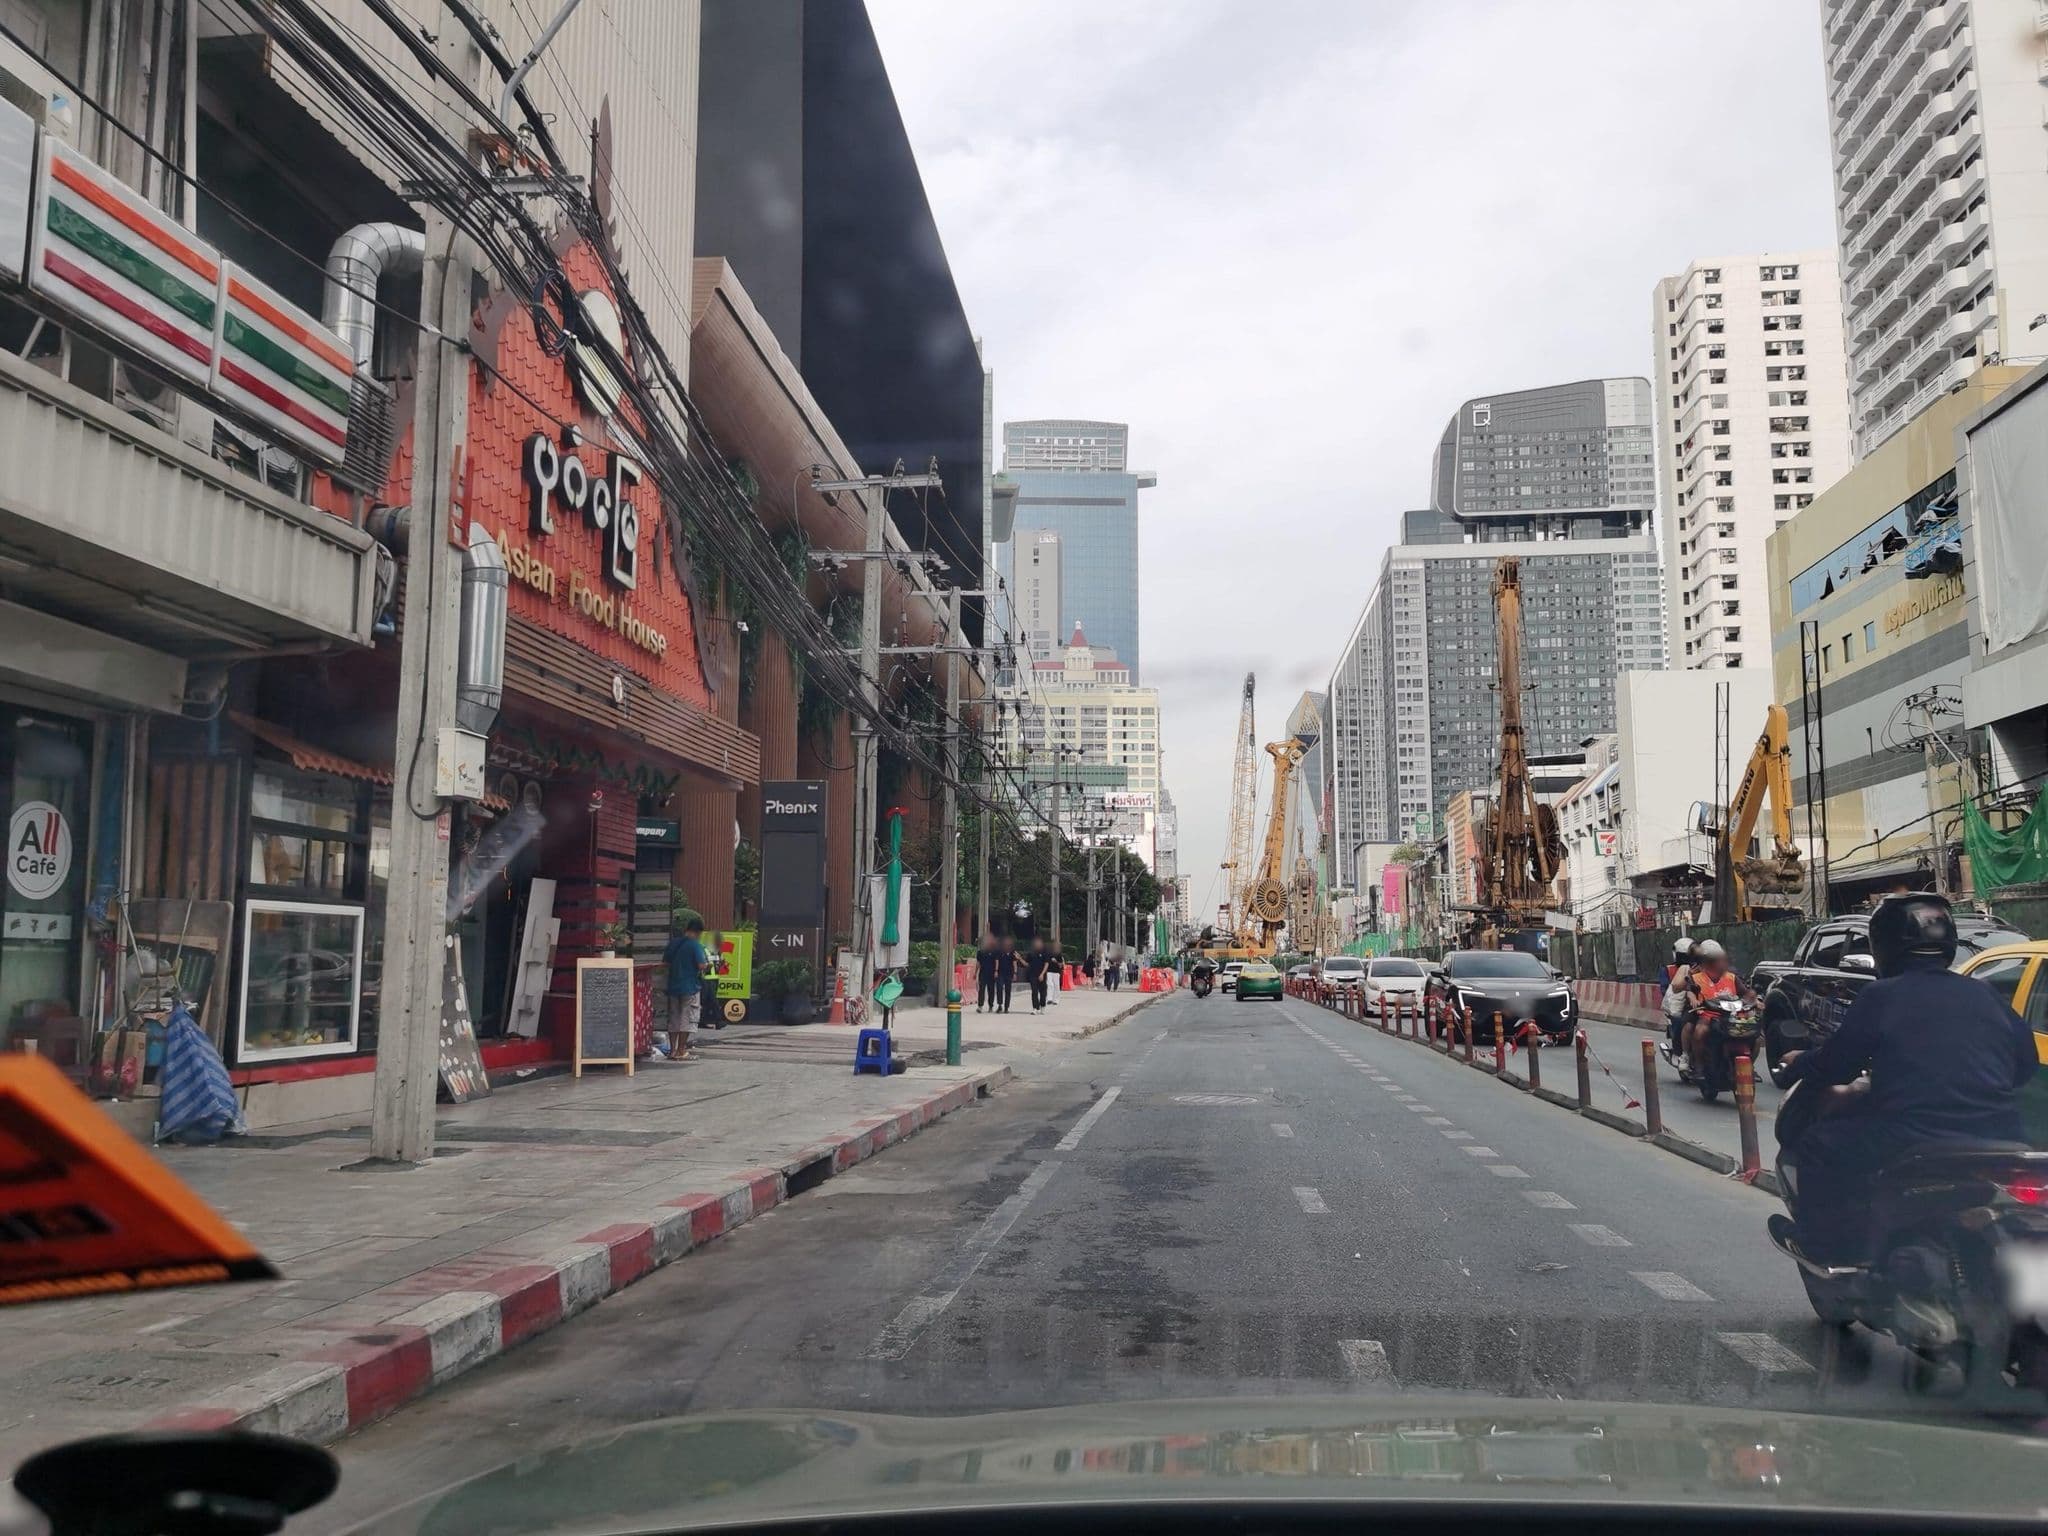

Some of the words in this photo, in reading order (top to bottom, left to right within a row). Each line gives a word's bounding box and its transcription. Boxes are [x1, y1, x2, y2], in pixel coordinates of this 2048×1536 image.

[495, 529, 555, 597] Asian
[568, 571, 614, 628] Food
[619, 601, 668, 657] House
[765, 800, 818, 814] Phenix
[18, 812, 60, 855] All
[17, 856, 57, 876] Café
[787, 934, 804, 947] IN
[719, 982, 744, 990] OPEN
[731, 1003, 739, 1012] G
